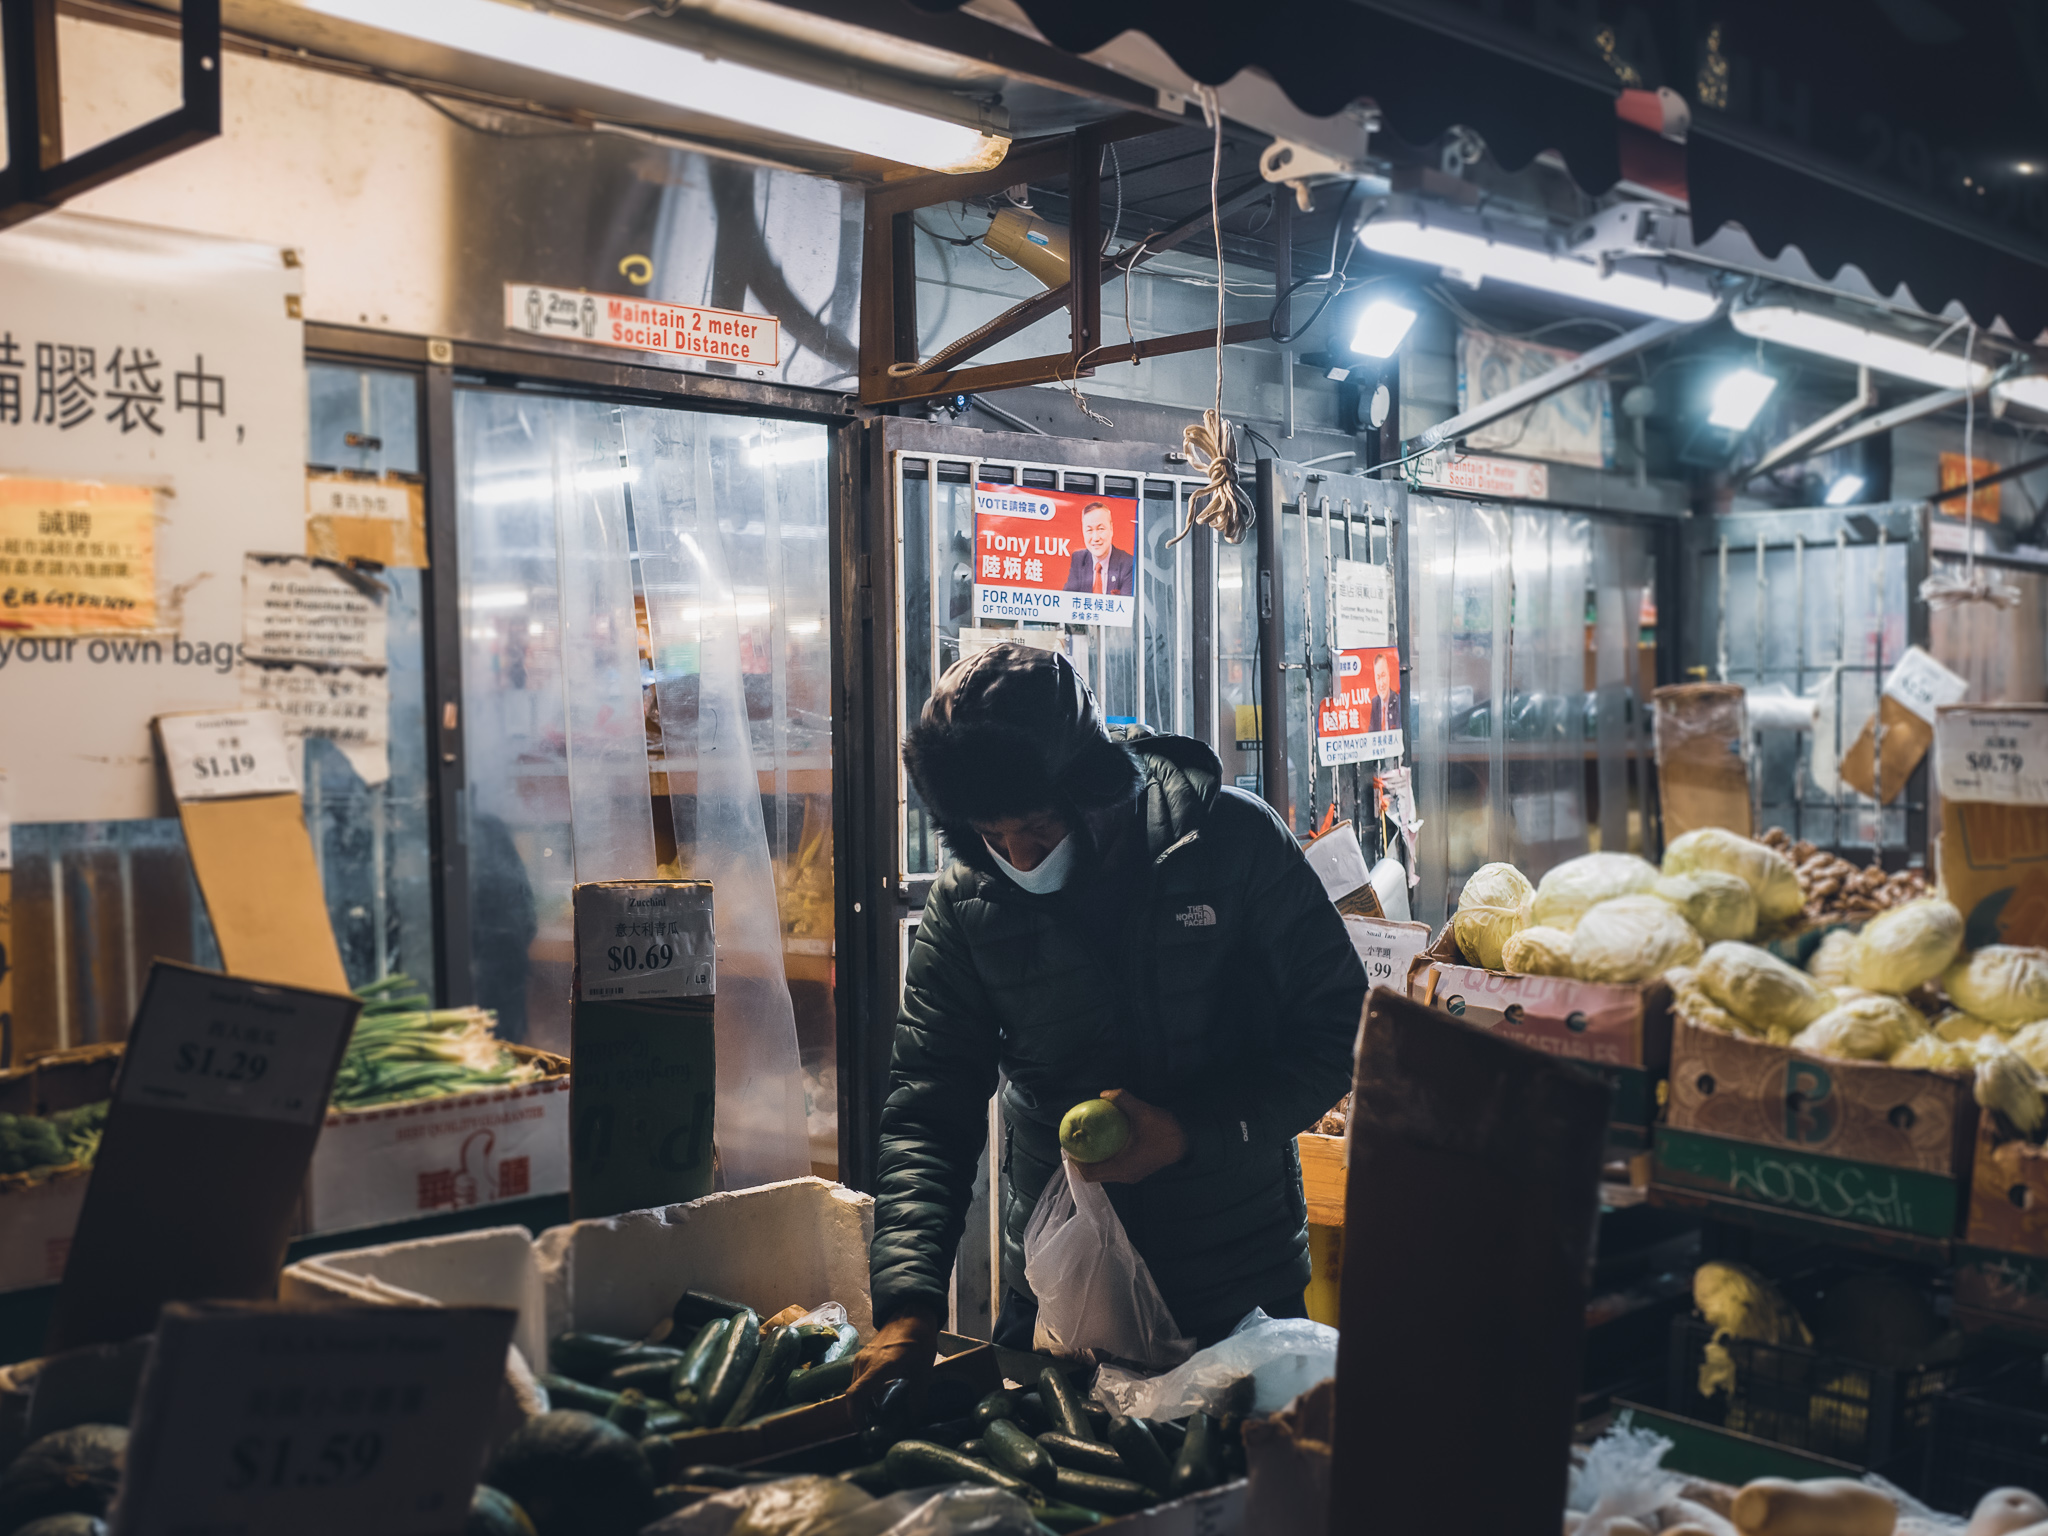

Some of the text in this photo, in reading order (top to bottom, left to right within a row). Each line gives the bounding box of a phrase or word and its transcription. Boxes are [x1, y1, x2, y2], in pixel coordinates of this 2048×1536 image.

[548, 293, 577, 314] 2m
[607, 300, 758, 339] Maintain 2 meter
[612, 321, 751, 358] Social Distance
[1449, 472, 1475, 487] Social
[978, 497, 1036, 514] VOTE 請投票
[982, 530, 1071, 557] Tony LUK
[982, 554, 1043, 582] 陸炳雄
[983, 589, 1060, 608] FOR MAYOR
[1072, 597, 1125, 613] 市長候選人
[983, 605, 1039, 617] OF TORONTO
[1072, 611, 1100, 621] 多倫多市
[88, 640, 162, 666] own
[173, 638, 245, 674] bags
[1351, 688, 1371, 705] LUK
[1326, 737, 1367, 752] FOR MAYOR
[192, 753, 256, 780] $1.19
[1966, 750, 2024, 774] $0.79
[629, 897, 667, 908] Zucchini
[1176, 912, 1203, 921] NORTH
[1184, 919, 1204, 927] FACE
[615, 921, 680, 937] 意大利青瓜
[607, 943, 673, 973] $0.69
[695, 975, 706, 983] LB
[175, 1042, 268, 1083] $1.29
[428, 1117, 480, 1138] QUALITY
[225, 1430, 385, 1491] $1.59
